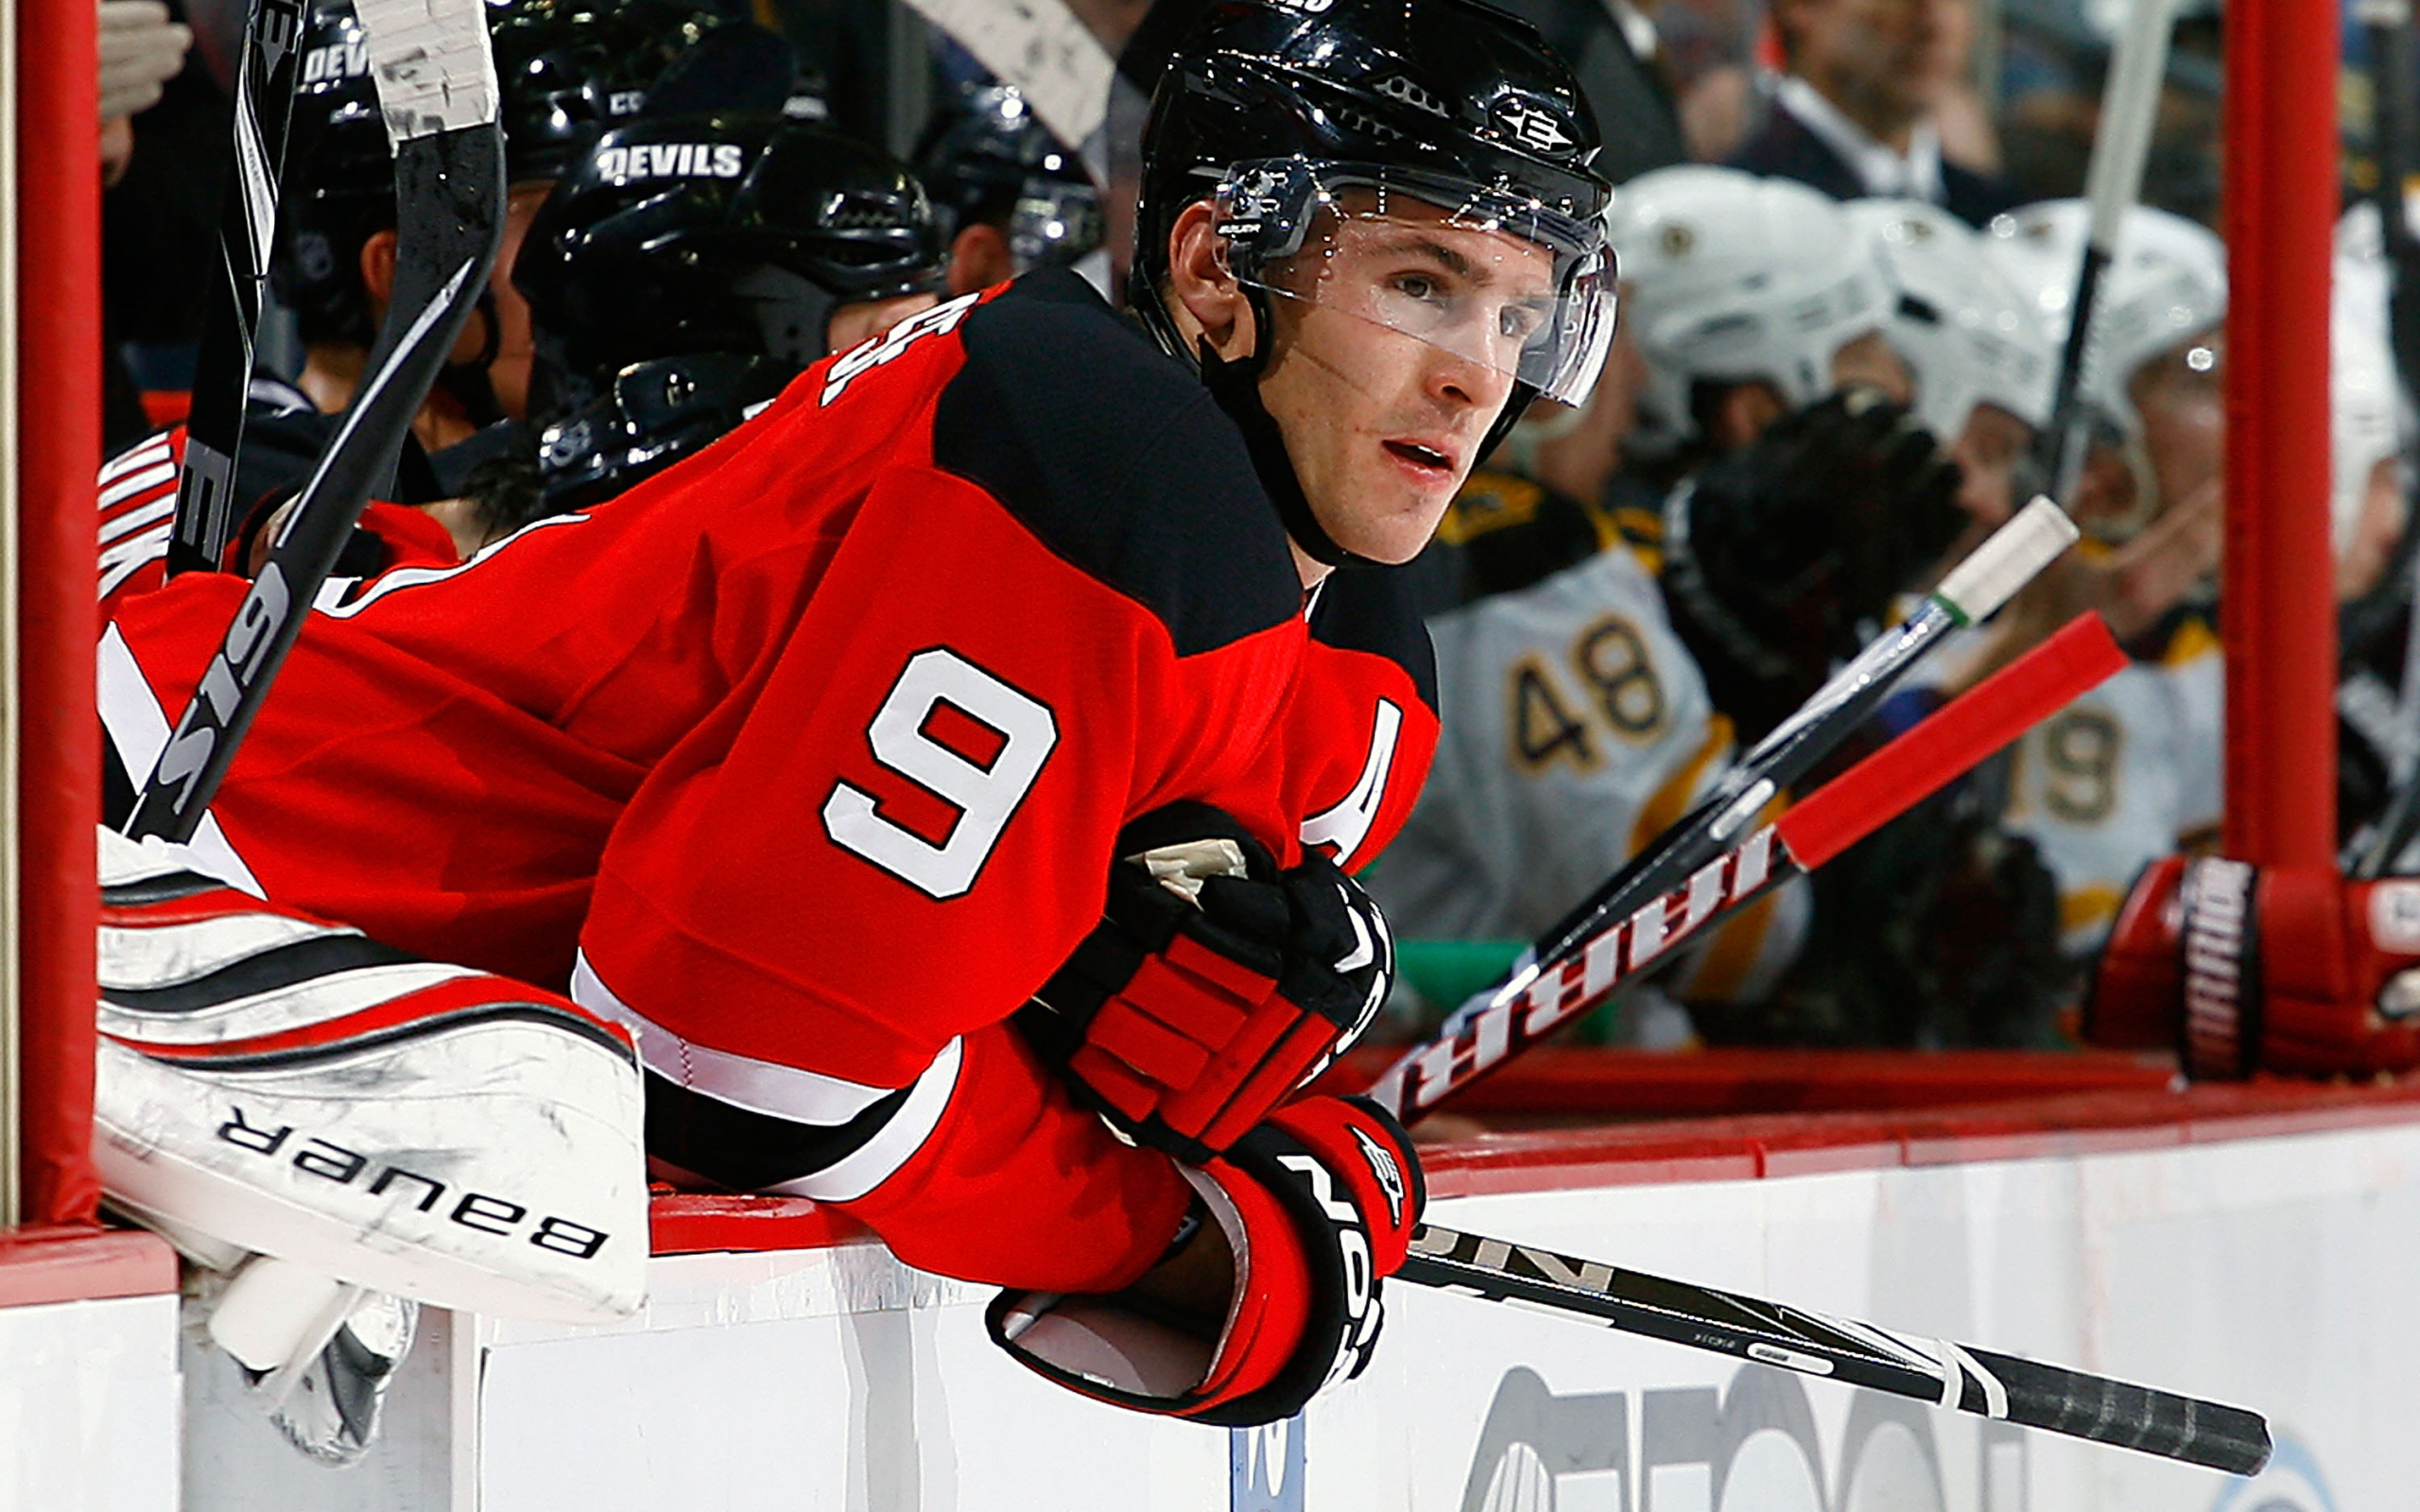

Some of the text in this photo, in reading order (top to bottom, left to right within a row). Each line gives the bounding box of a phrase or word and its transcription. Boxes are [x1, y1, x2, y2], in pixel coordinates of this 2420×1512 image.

[303, 43, 371, 82] DEV
[598, 144, 744, 180] DEVILS
[158, 560, 290, 816] S19
[1505, 611, 1674, 779] 48
[819, 644, 1061, 902] 9
